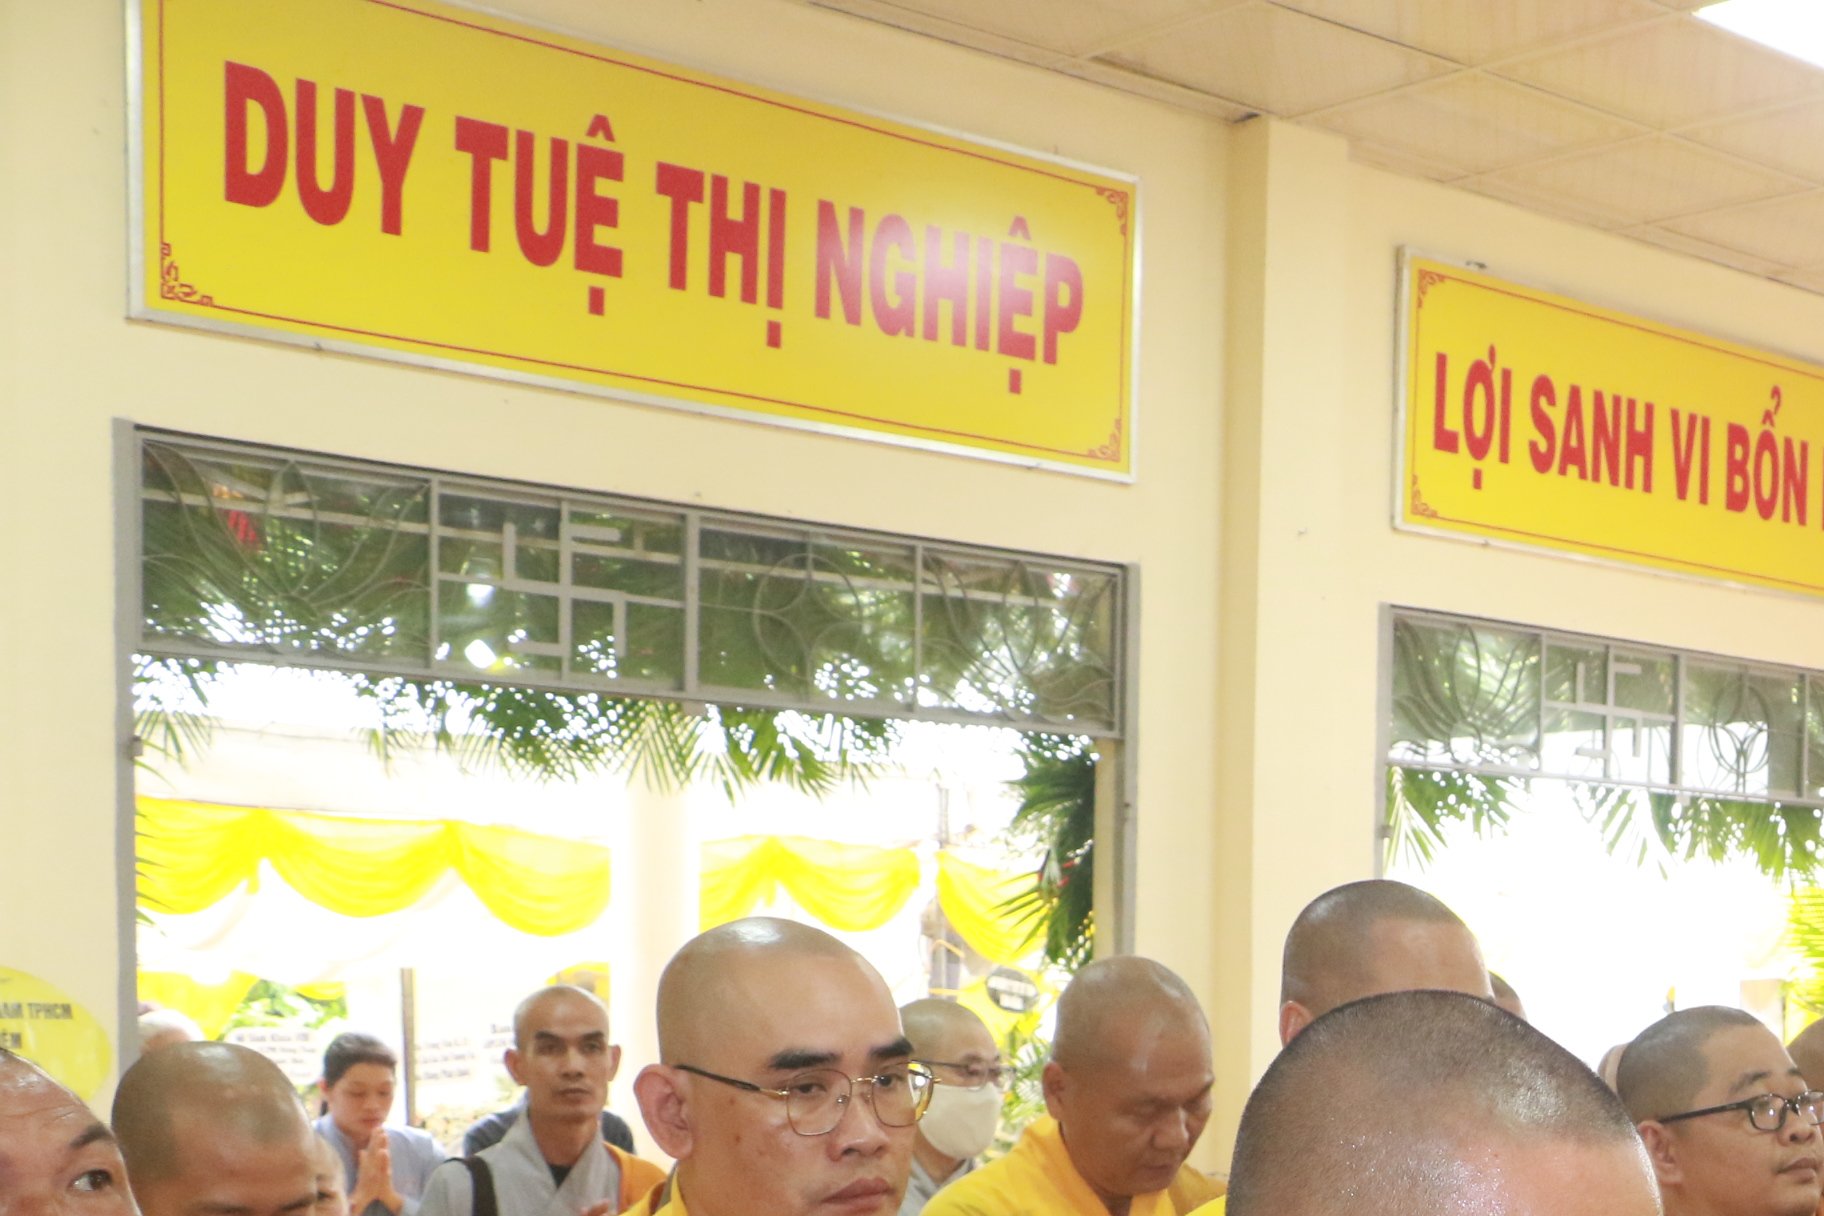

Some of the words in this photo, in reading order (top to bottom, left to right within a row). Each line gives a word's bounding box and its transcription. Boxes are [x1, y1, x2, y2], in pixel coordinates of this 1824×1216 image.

[224, 60, 427, 236] DUY
[453, 113, 625, 316] TUỆ
[655, 160, 788, 349] THỊ
[815, 198, 1084, 395] NGHIỆP
[1433, 344, 1514, 491] LỢI
[1527, 373, 1657, 495] SANH
[1669, 406, 1712, 507] VI
[1723, 384, 1811, 528] BỔN
